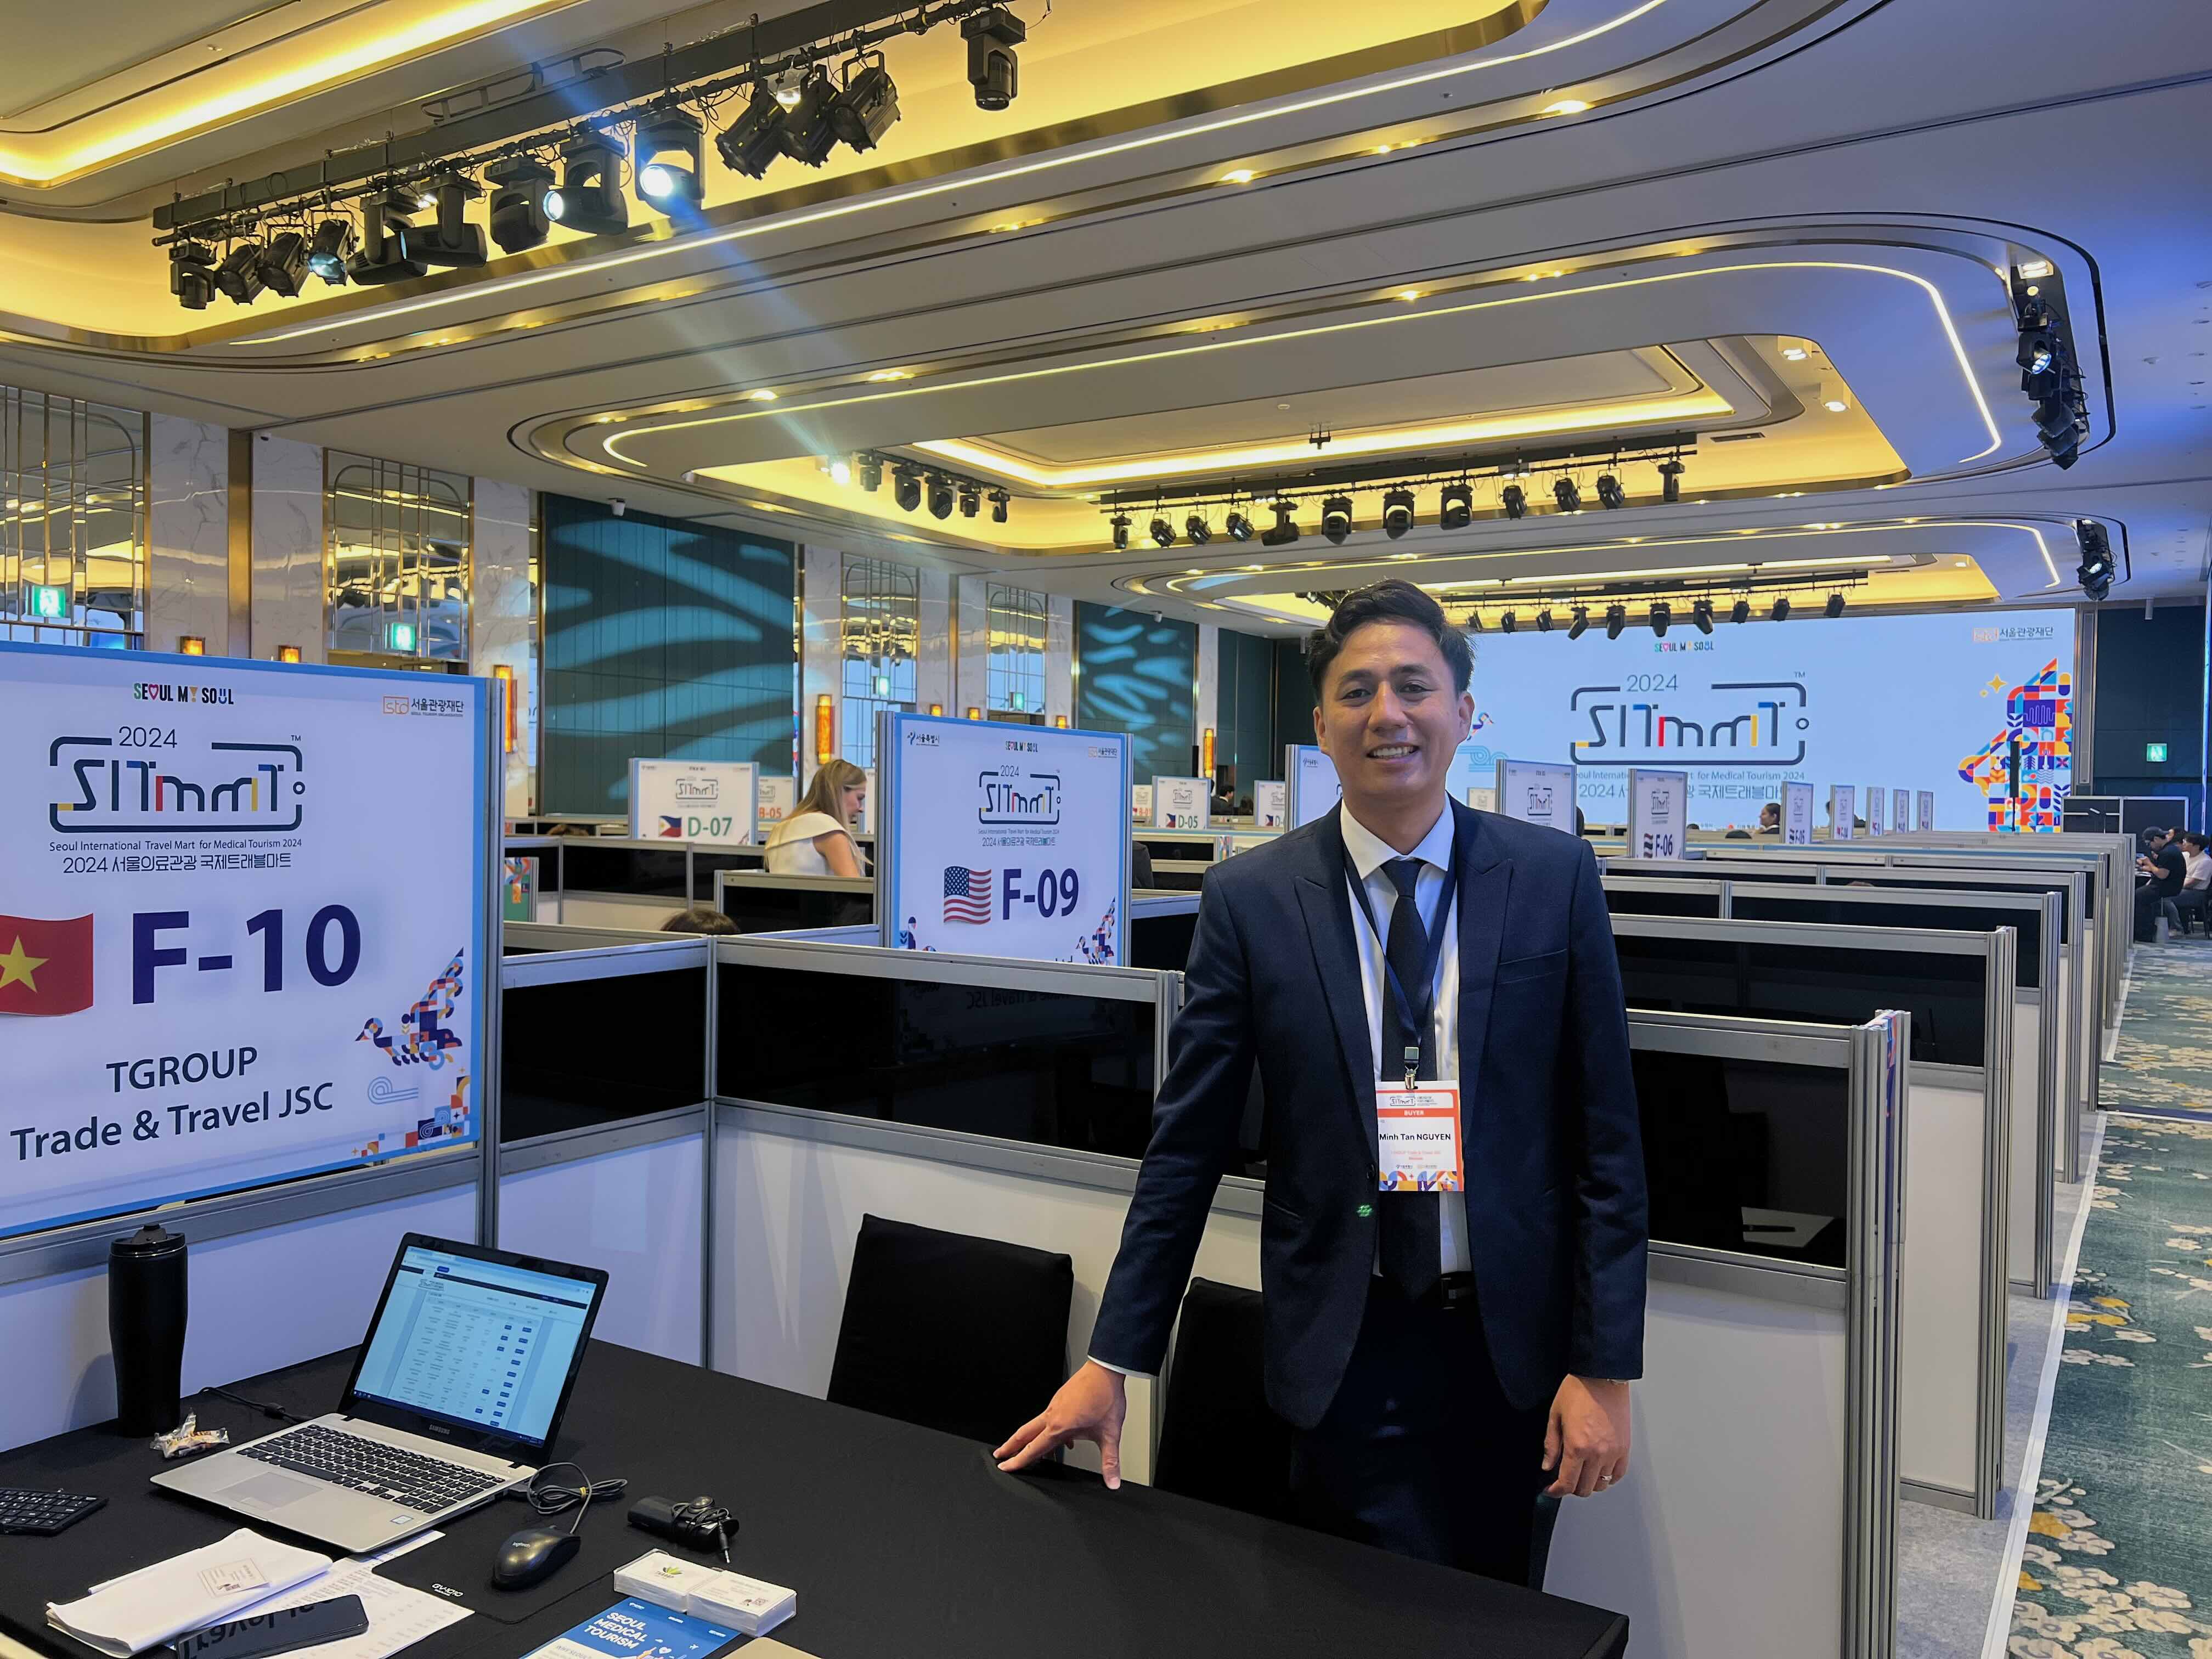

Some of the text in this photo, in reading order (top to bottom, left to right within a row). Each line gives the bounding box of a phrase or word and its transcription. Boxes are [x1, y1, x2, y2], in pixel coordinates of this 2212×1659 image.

[1627, 674, 1679, 692] 2024
[411, 698, 464, 713] 서울관광재단
[119, 726, 178, 748] 2024
[1000, 765, 1020, 777] 2024
[1576, 771, 1592, 779] eoul
[1697, 771, 1709, 780] for
[1711, 771, 1745, 780] Medical
[1747, 771, 1781, 780] Tourism
[1784, 771, 1805, 780] 2024
[1579, 784, 1615, 798] 2024
[687, 817, 732, 837] D-07
[1178, 815, 1198, 828] D-05
[49, 838, 302, 851] Seoul International Travel Mart for Medical Tourism 2024
[982, 837, 997, 847] 2024
[1655, 833, 1673, 856] F-06
[63, 853, 291, 873] 2024 서울의료관광 국제트래블마트
[1002, 868, 1079, 921] F-09
[132, 904, 362, 1005] F-10
[106, 1046, 258, 1093] TGROUP
[10, 1082, 333, 1161] Trade & Travel JSC
[594, 1618, 648, 1643] MEDICAL
[606, 1612, 646, 1630] SEOUL
[583, 1624, 640, 1649] TOURISM
